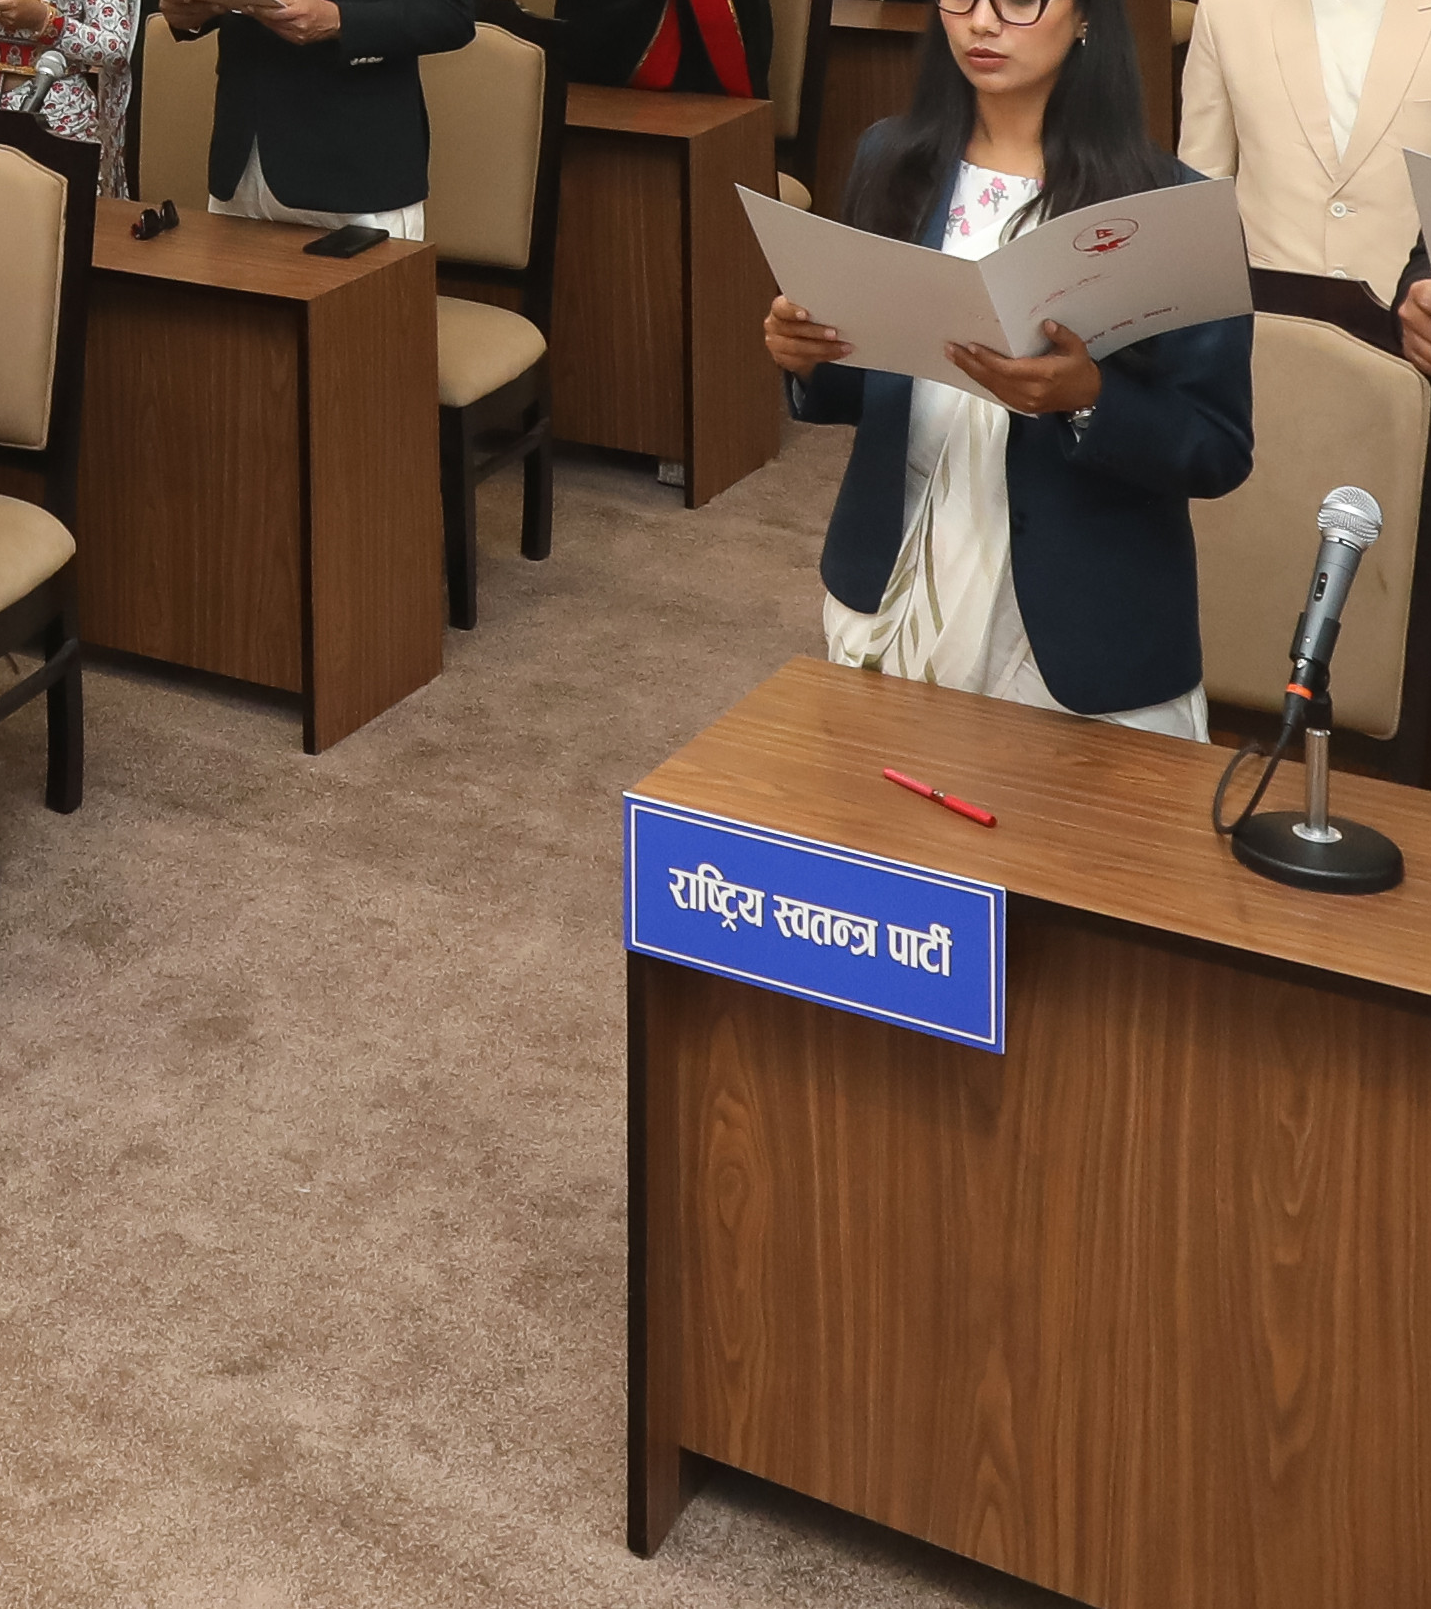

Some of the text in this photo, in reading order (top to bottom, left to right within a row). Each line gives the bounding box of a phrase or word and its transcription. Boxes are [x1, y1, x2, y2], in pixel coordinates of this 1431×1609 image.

[668, 863, 953, 977] राष्ट्रिय स्वतन्त्र पार्टी
